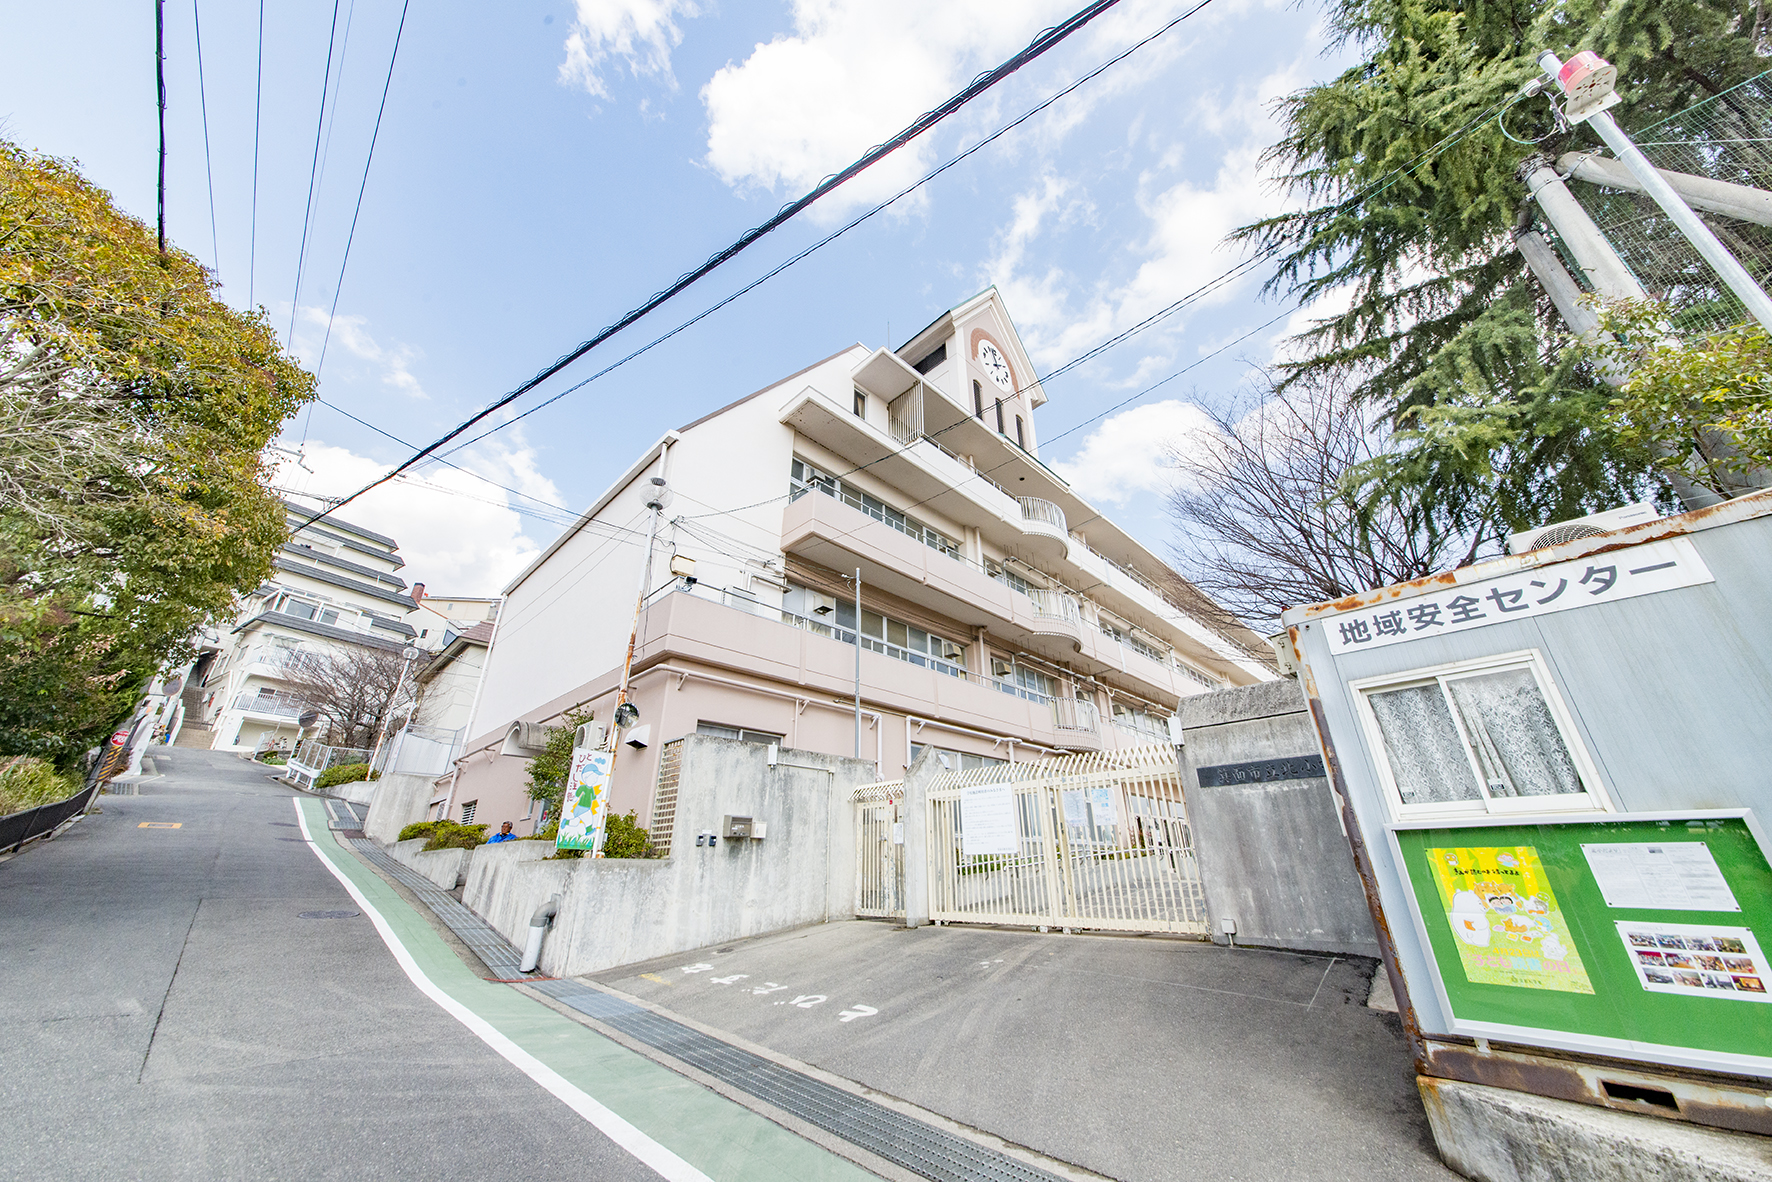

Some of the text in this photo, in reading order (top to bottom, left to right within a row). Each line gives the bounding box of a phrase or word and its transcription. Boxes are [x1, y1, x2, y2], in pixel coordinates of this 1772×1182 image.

[1618, 511, 1647, 520] Panasonic
[1338, 561, 1677, 645] 地域安全センター
[1216, 759, 1325, 783] 箕面市立北小
[1492, 947, 1541, 958] 4月23日は
